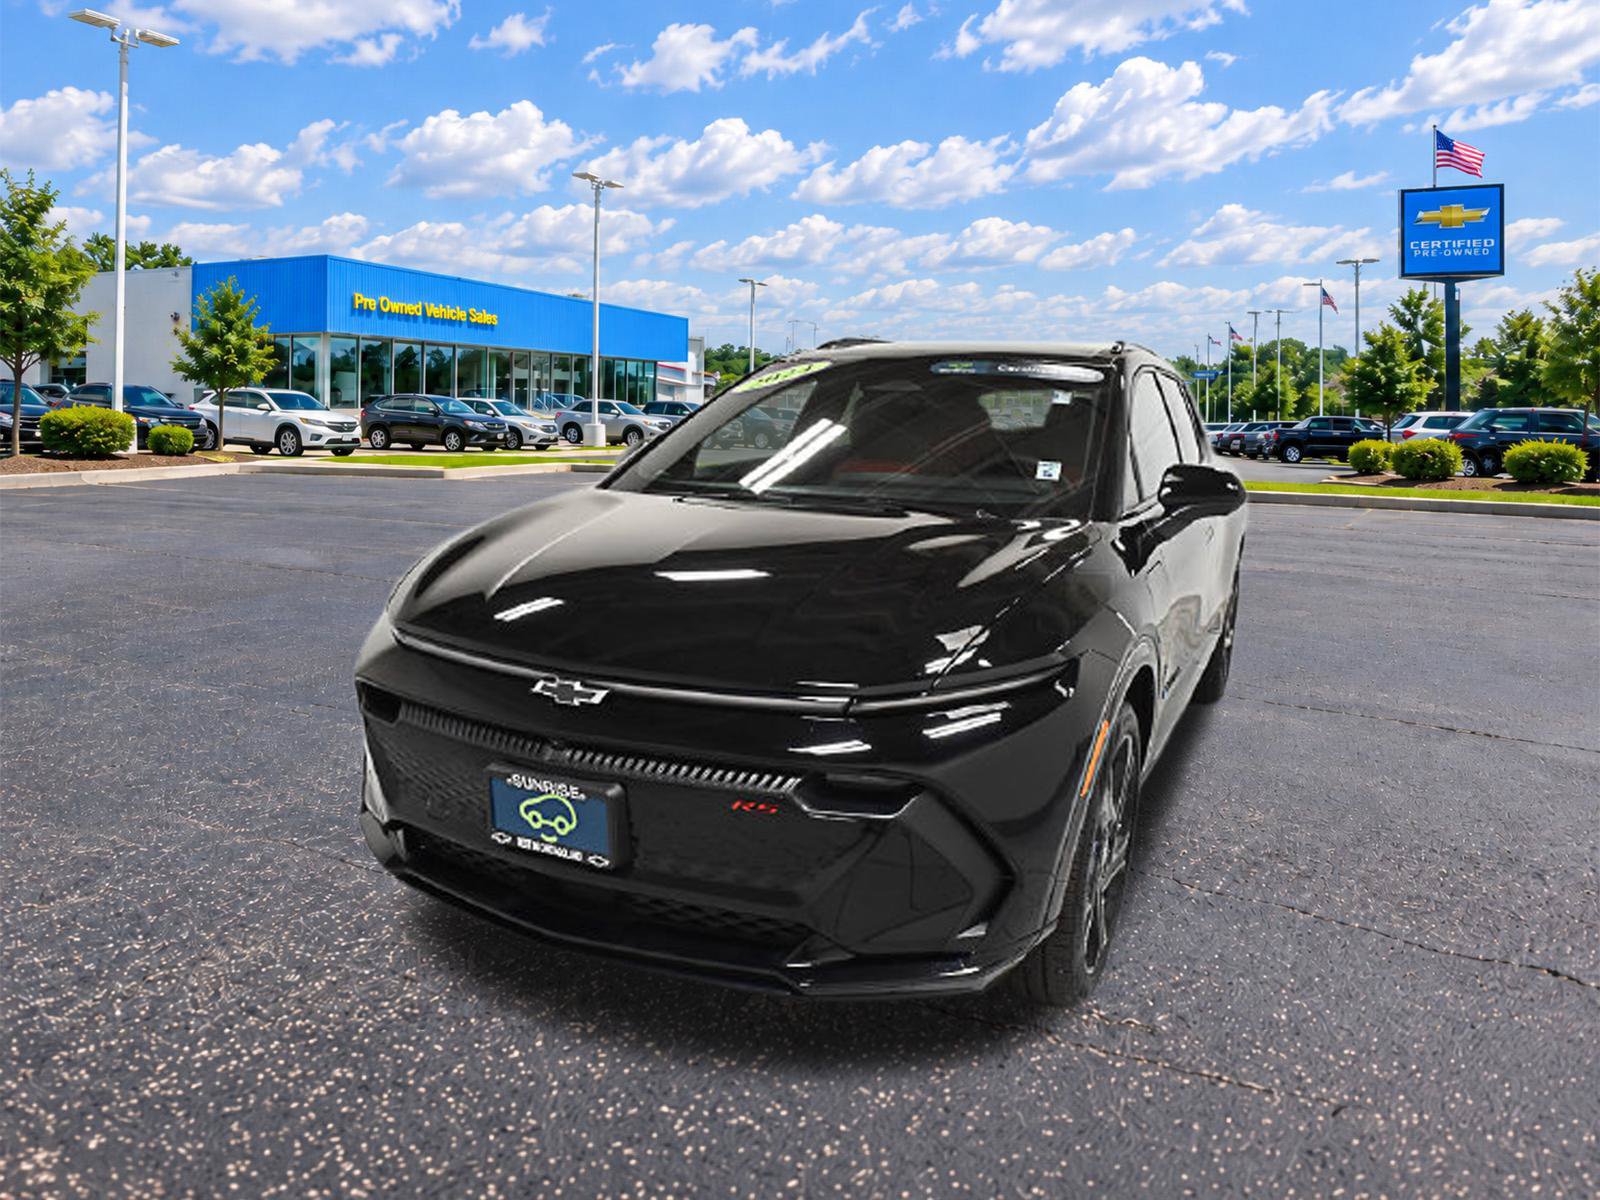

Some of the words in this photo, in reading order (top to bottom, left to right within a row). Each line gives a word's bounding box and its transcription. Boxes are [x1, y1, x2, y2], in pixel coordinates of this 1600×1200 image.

[1410, 238, 1495, 250] CERTIFIED
[1414, 248, 1490, 257] PRE-OWNED
[353, 292, 377, 311] Pre
[379, 295, 422, 317] Owned
[424, 301, 467, 322] Vehicle
[469, 307, 498, 326] Sales
[511, 773, 580, 800] SUNRISE
